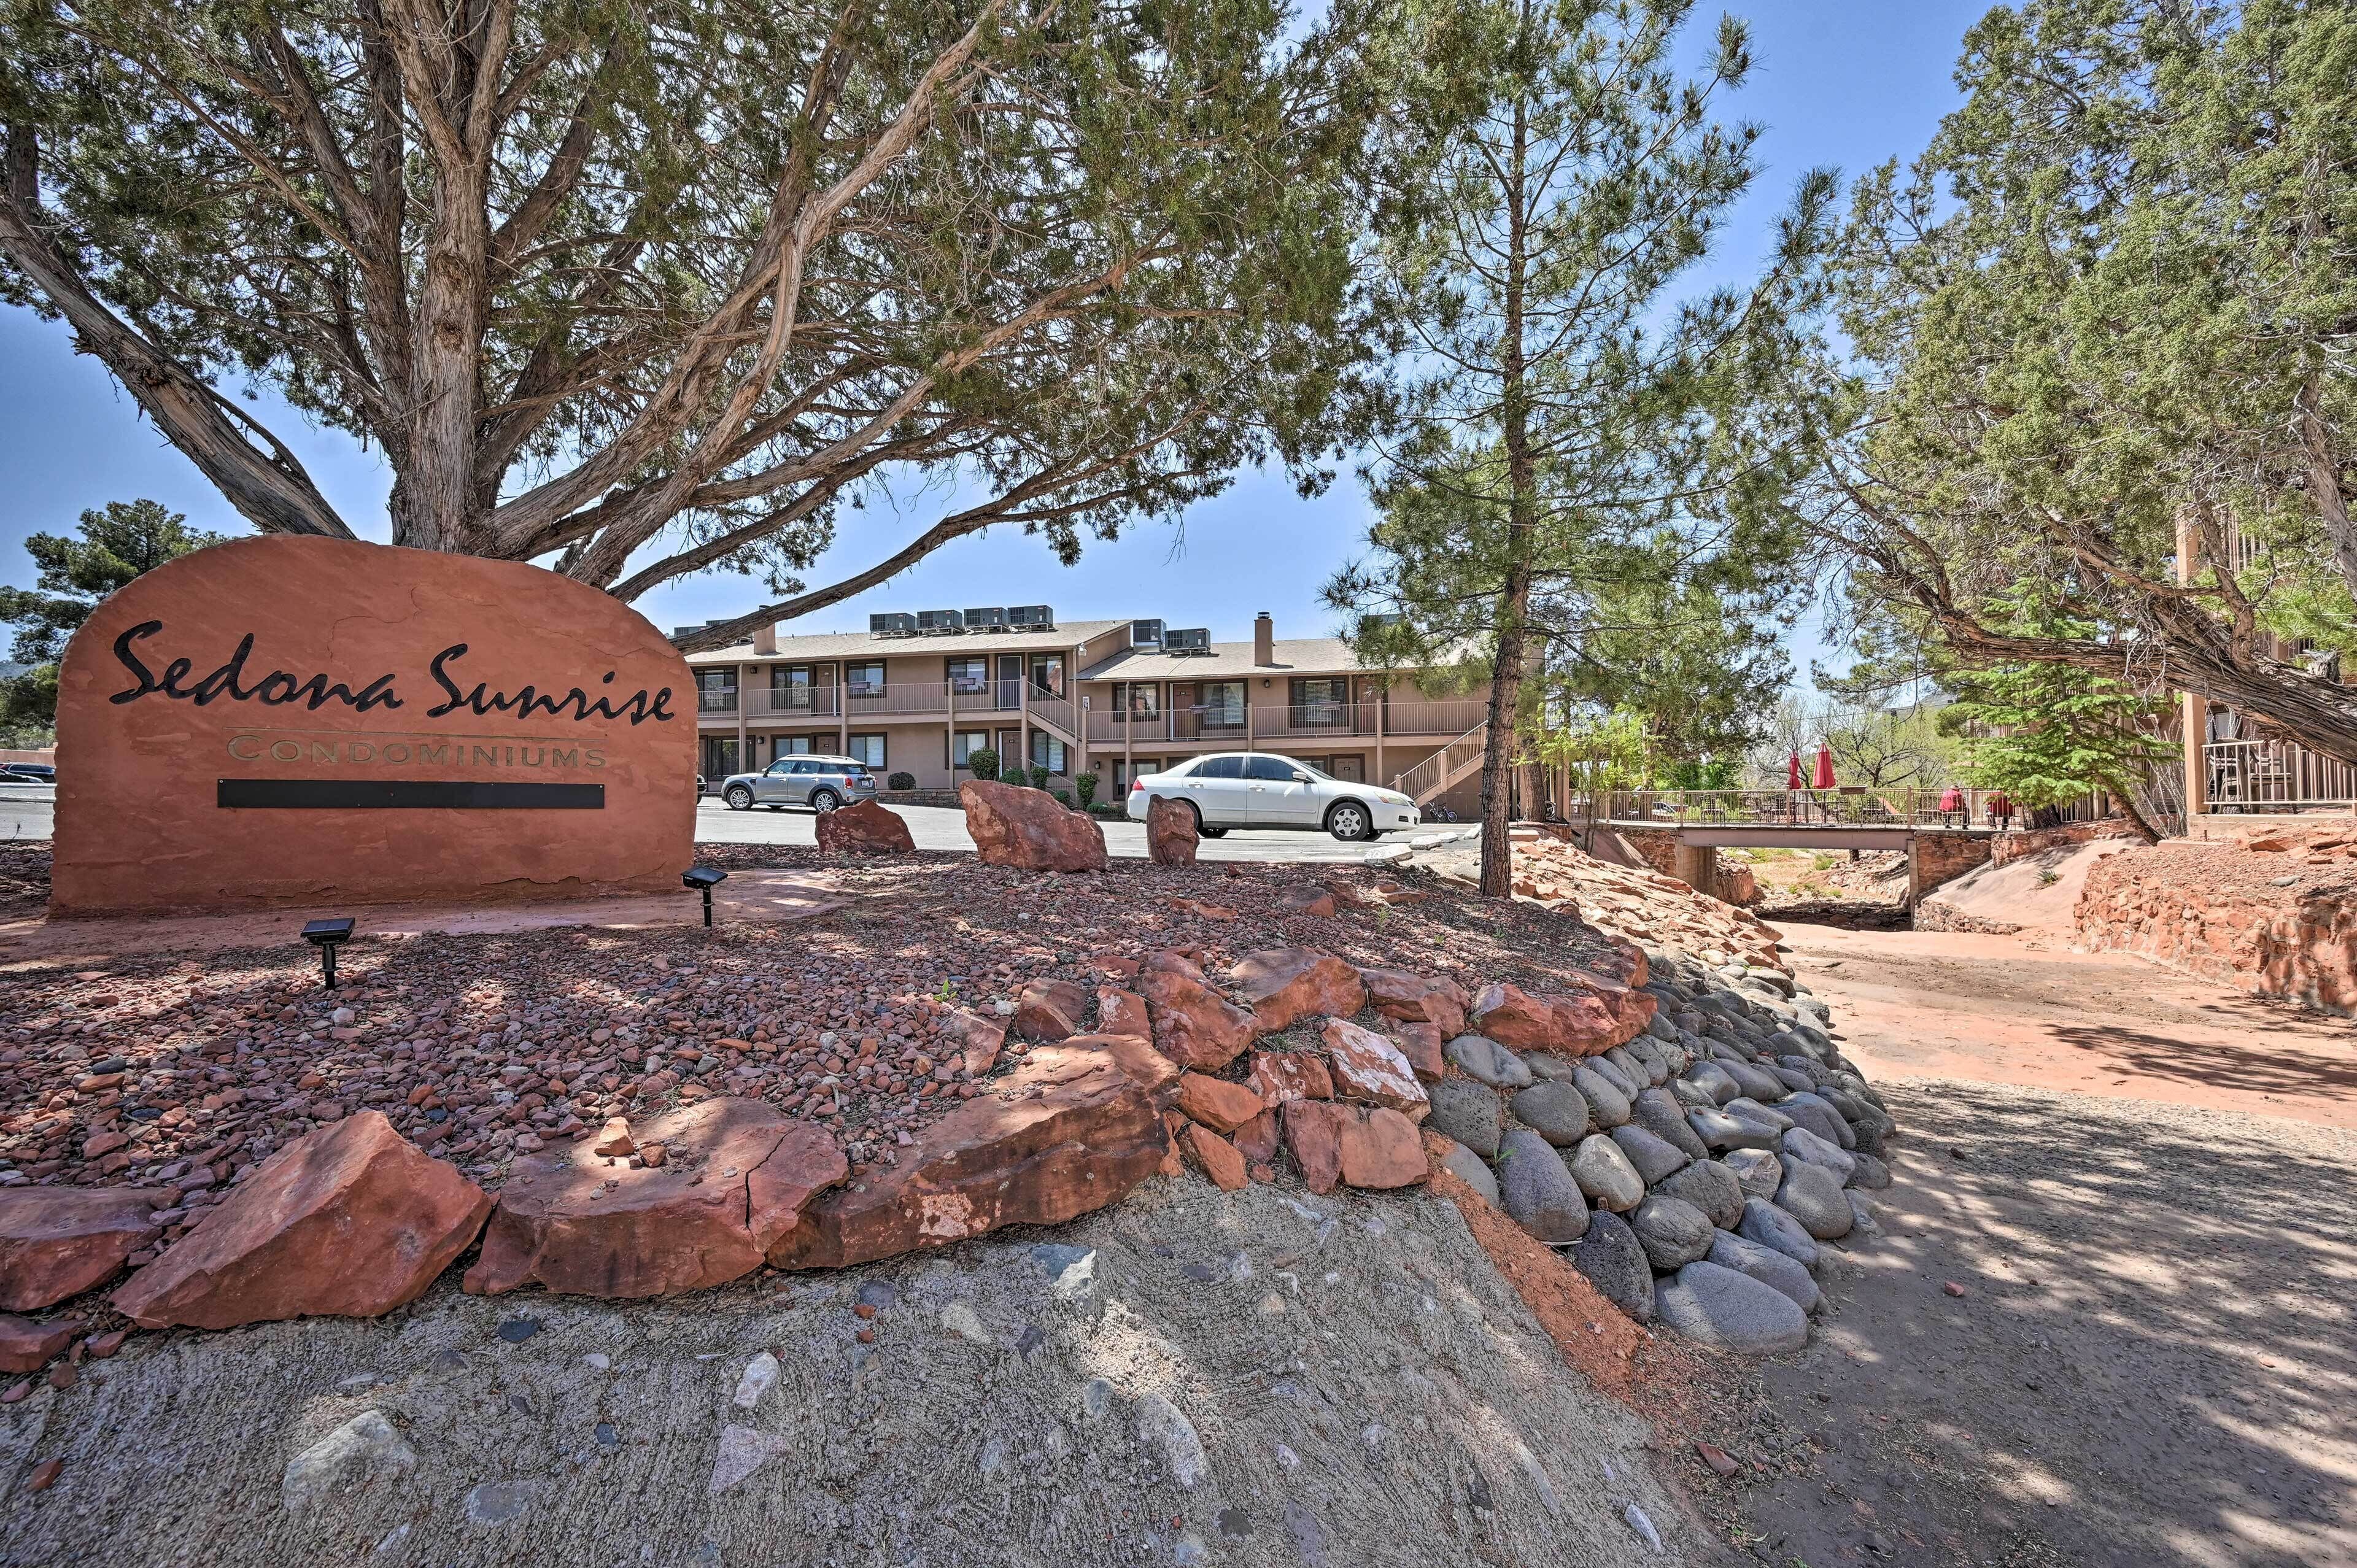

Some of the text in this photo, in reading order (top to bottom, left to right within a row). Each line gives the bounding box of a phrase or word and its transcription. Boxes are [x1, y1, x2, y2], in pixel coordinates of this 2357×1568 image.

[109, 619, 675, 726] Sedona Sunrise
[226, 735, 606, 767] CONDOMINIUMS
